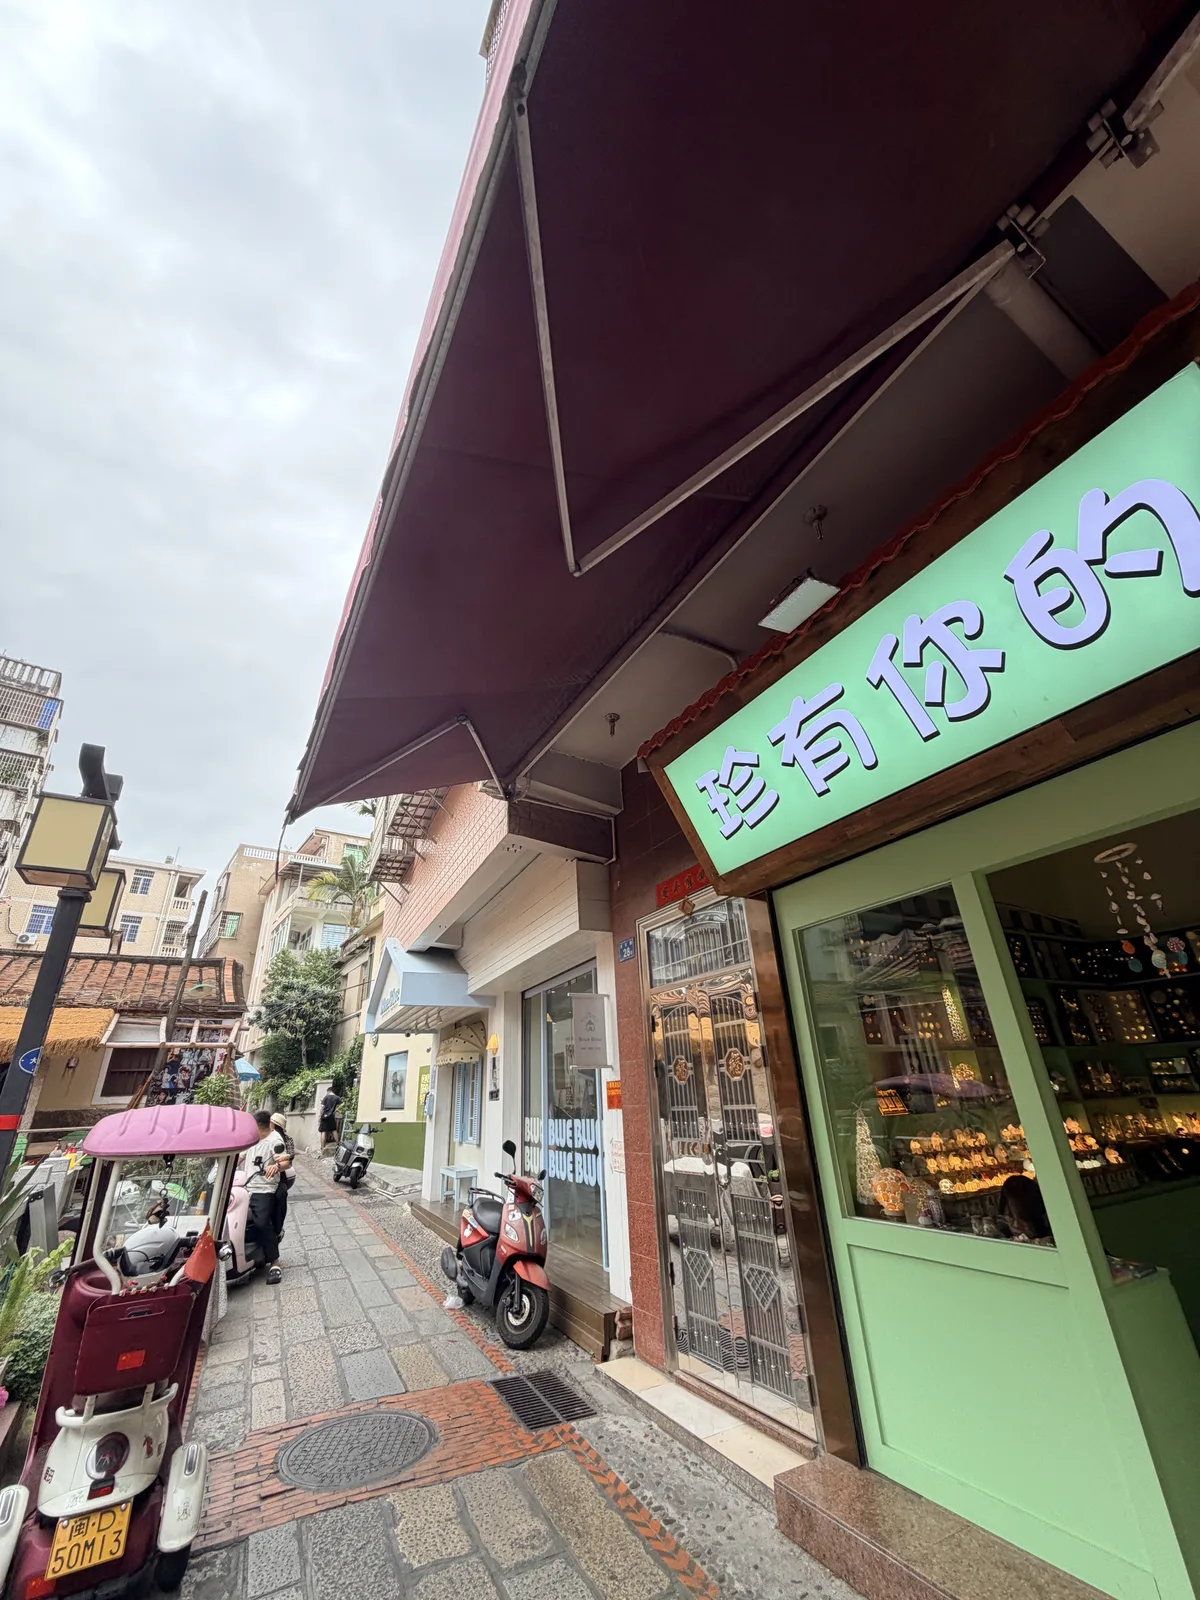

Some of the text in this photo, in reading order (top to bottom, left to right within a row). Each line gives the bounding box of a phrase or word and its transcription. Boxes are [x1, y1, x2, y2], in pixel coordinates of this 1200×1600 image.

[695, 477, 1200, 840] 珍有你的
[525, 1146, 542, 1174] BLU
[52, 1530, 123, 1574] 50M13
